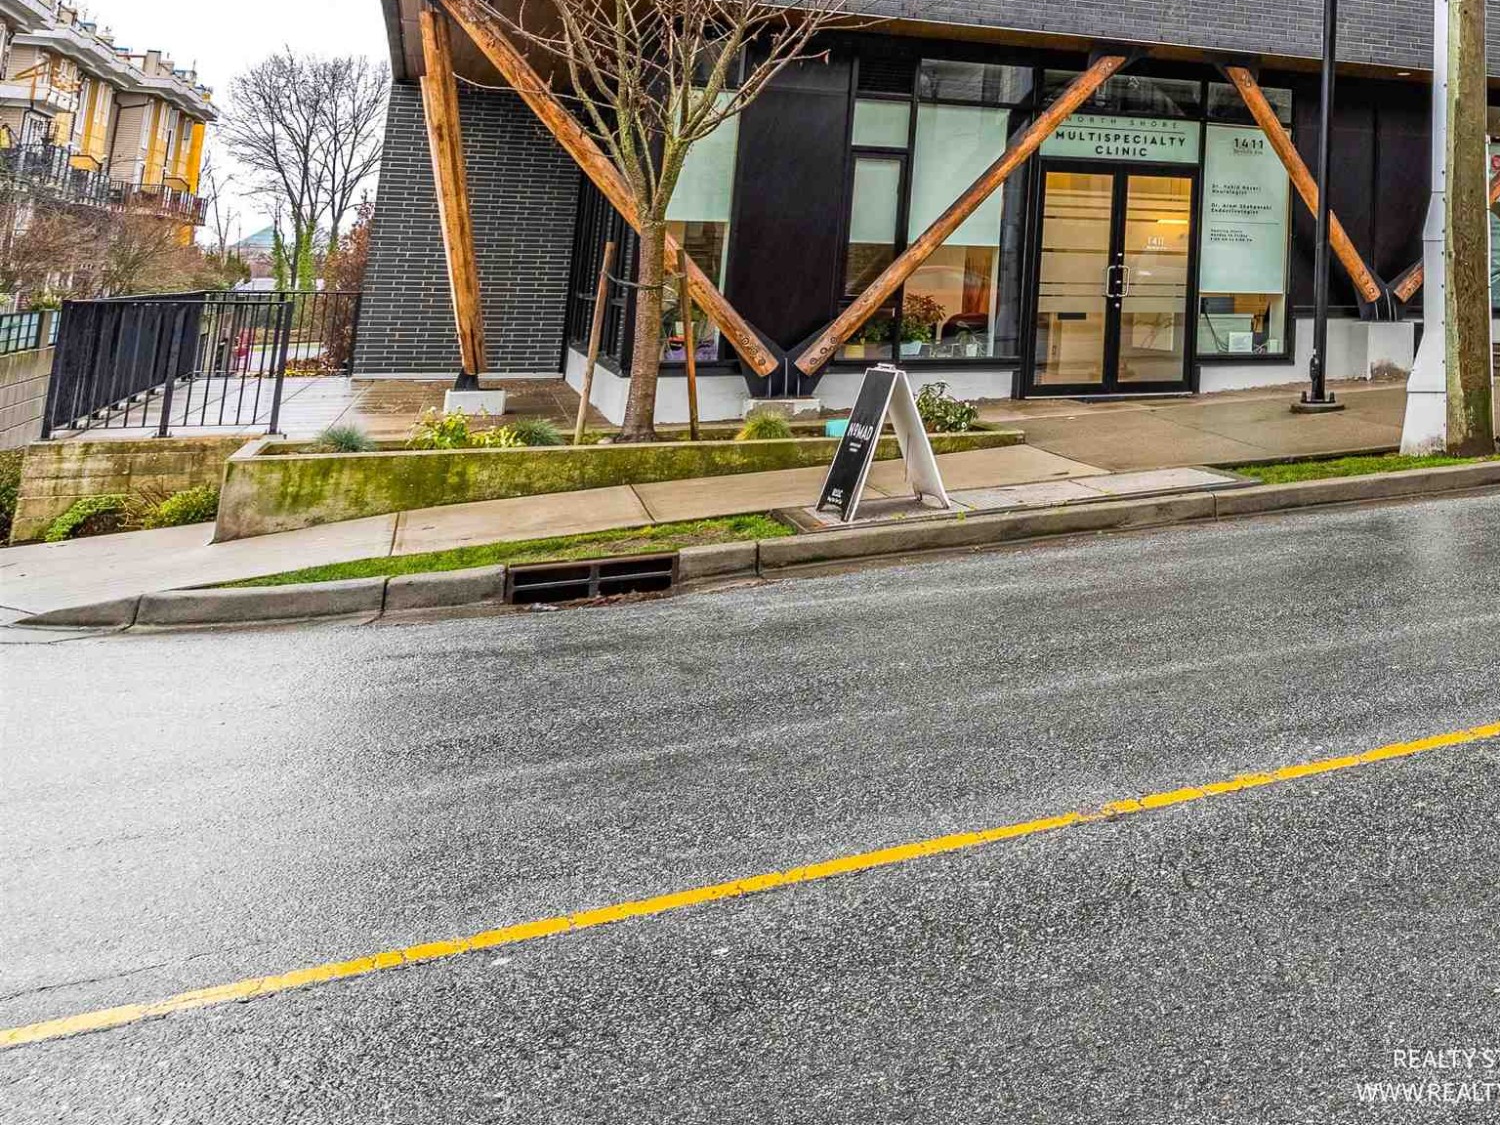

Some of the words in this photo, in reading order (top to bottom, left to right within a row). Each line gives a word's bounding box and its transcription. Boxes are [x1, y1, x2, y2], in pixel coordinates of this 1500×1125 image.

[1066, 114, 1117, 125] NORTH
[1130, 118, 1178, 130] SHORE
[1055, 130, 1187, 147] MULTISPECIALTY
[1234, 137, 1265, 150] 1411
[1095, 145, 1149, 157] CLINIC
[847, 422, 874, 441] NOMAD
